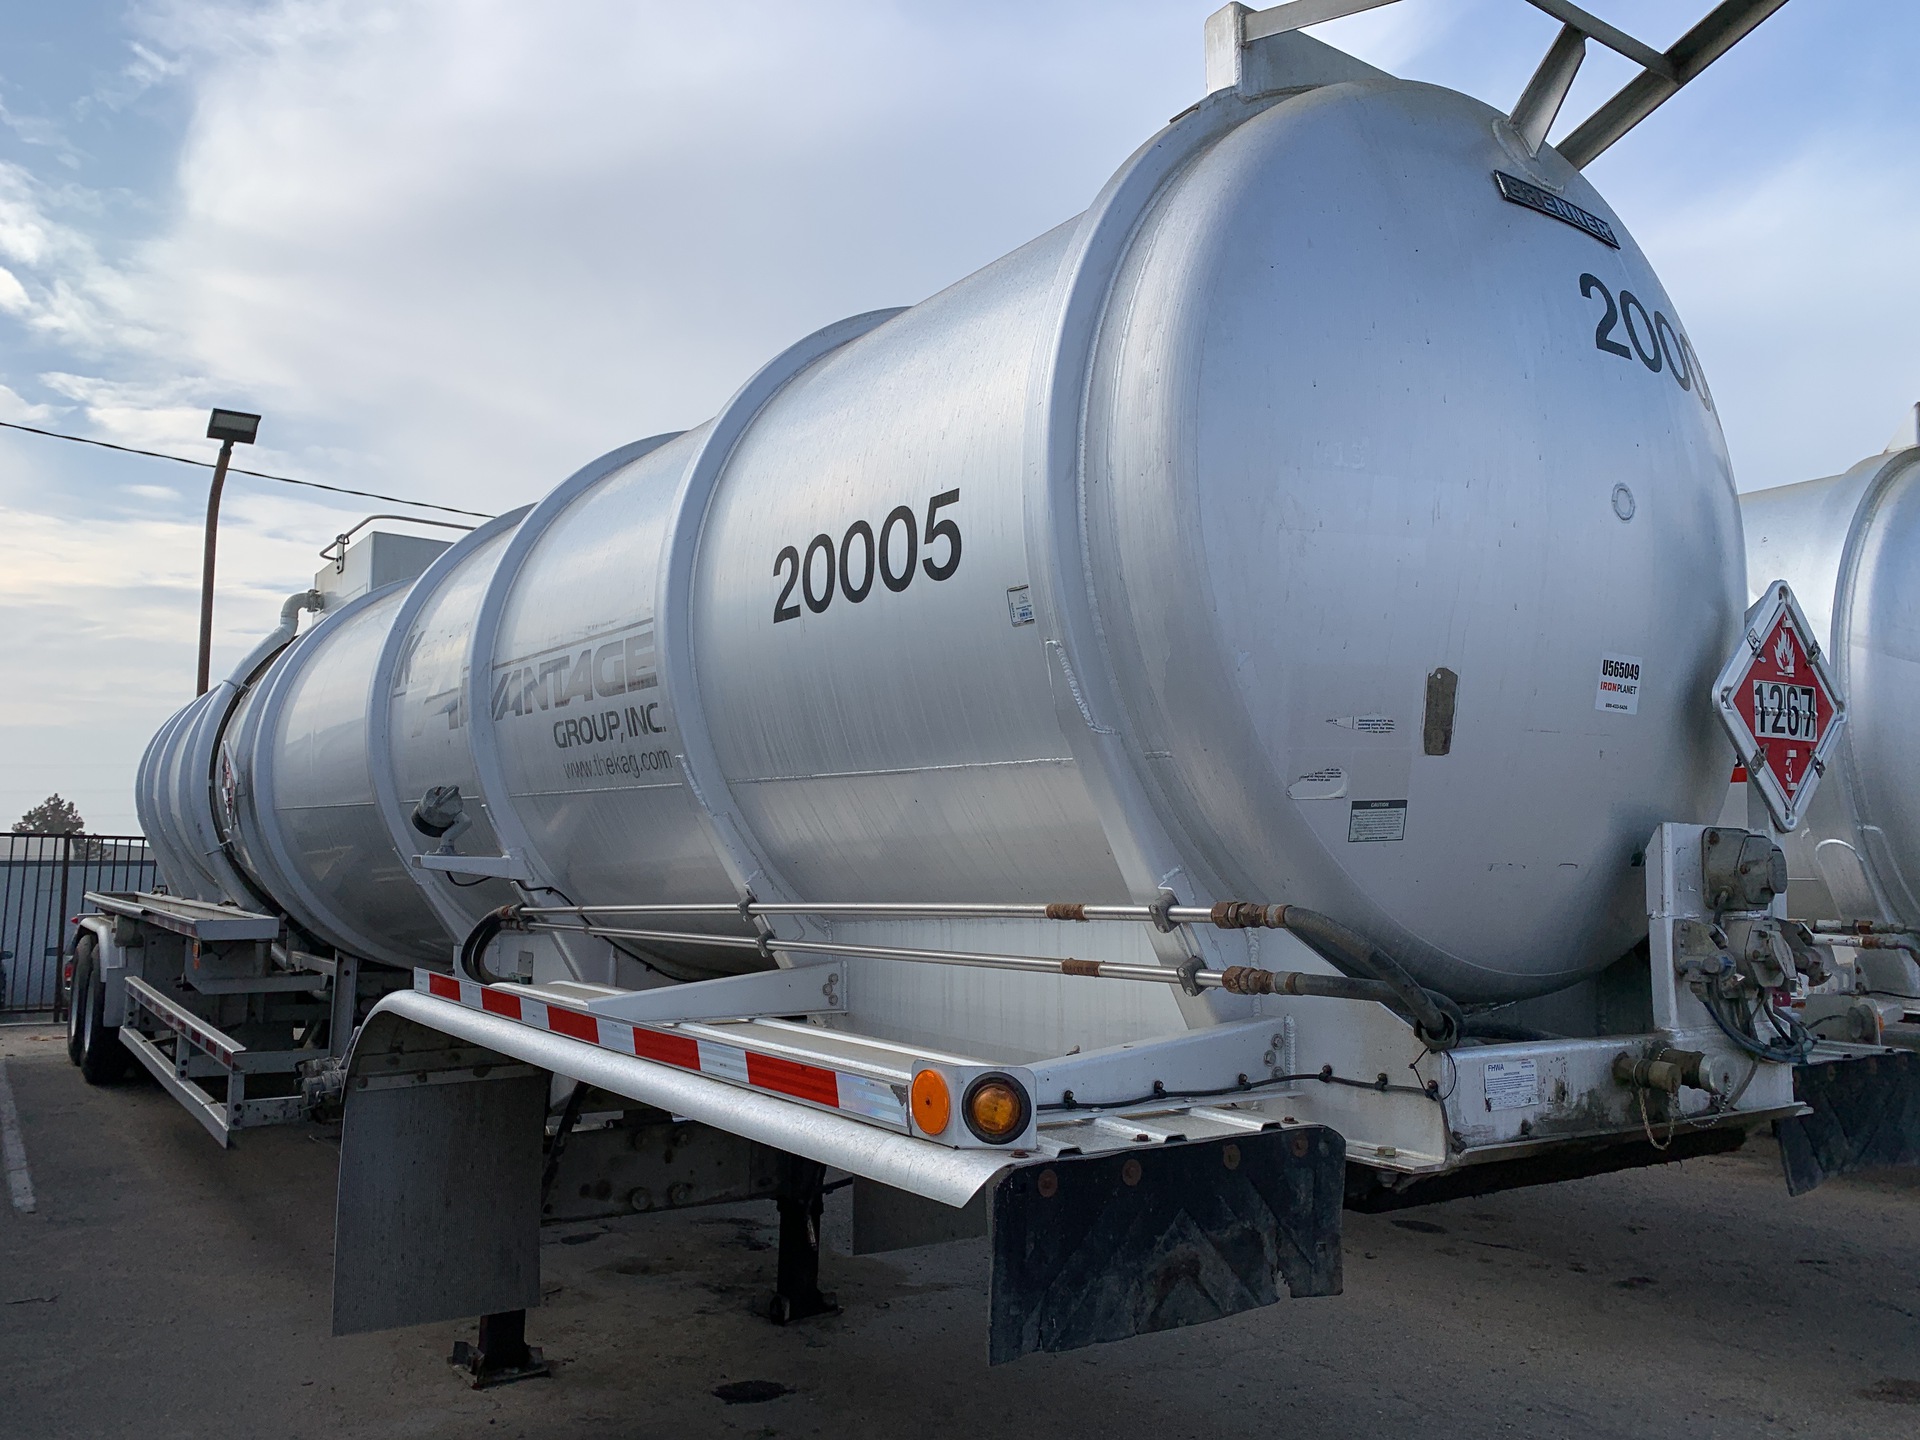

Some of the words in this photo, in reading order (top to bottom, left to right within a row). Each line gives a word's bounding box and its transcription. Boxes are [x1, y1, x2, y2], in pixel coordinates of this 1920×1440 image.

[1508, 181, 1614, 240] BRENNER
[773, 488, 962, 624] 20005
[1602, 659, 1640, 681] U565049
[1755, 684, 1813, 737] 1267
[563, 748, 674, 779] www.thekag.com
[1488, 1064, 1505, 1072] FHWA
